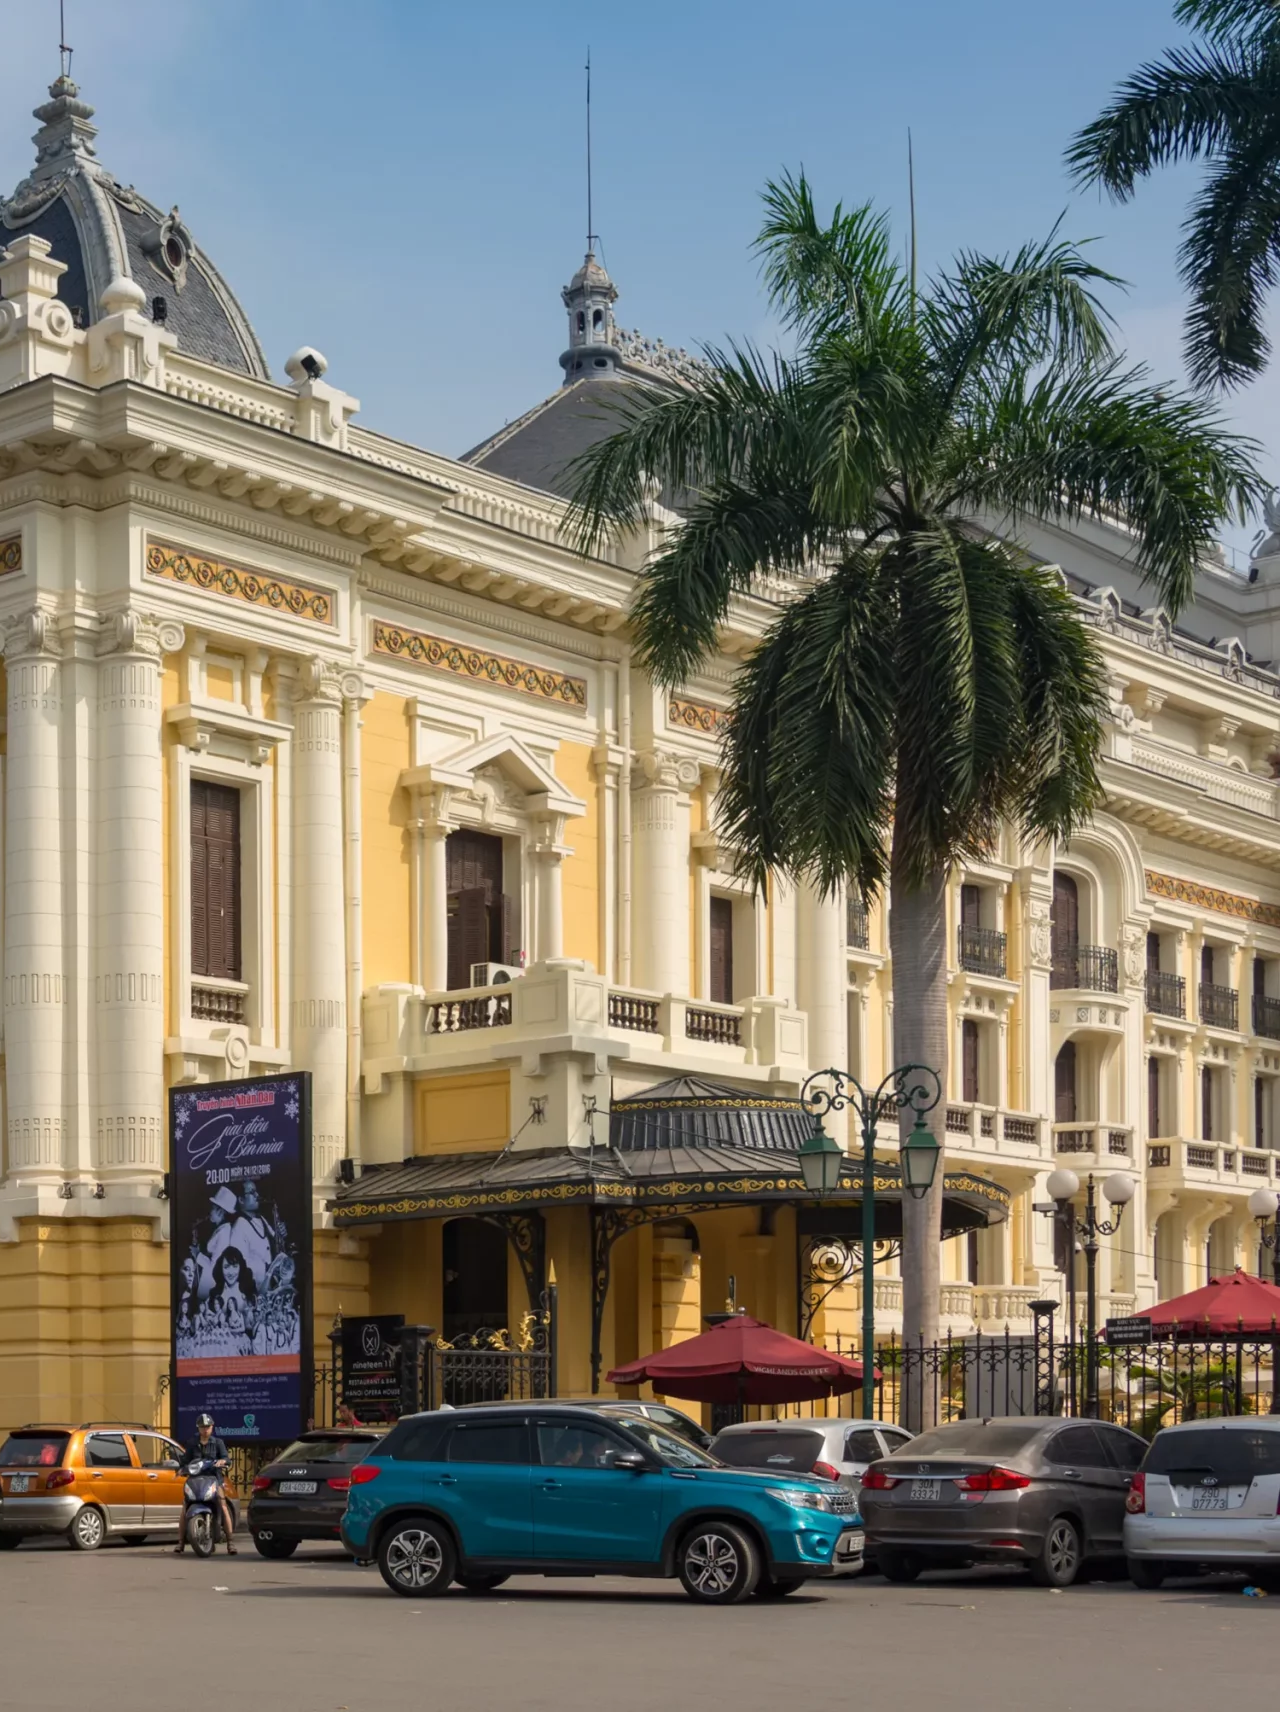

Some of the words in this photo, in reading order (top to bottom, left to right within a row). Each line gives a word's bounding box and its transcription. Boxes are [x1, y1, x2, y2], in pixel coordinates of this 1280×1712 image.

[235, 1092, 258, 1109] Nhân
[257, 1090, 275, 1107] Dân
[187, 1113, 244, 1170] Giai
[243, 1115, 270, 1137] điệu
[225, 1134, 258, 1163] Bốn
[256, 1137, 285, 1154] mùa
[206, 1167, 230, 1185] 20:00
[352, 1361, 383, 1370] nineteen
[798, 1367, 830, 1376] COFFEE
[348, 1378, 380, 1386] RESTAURANT
[345, 1389, 363, 1397] HANOI
[363, 1388, 382, 1396] OPERA
[918, 1478, 934, 1489] 30A
[1201, 1487, 1220, 1498] 29D
[1193, 1498, 1226, 1509] 077.73
